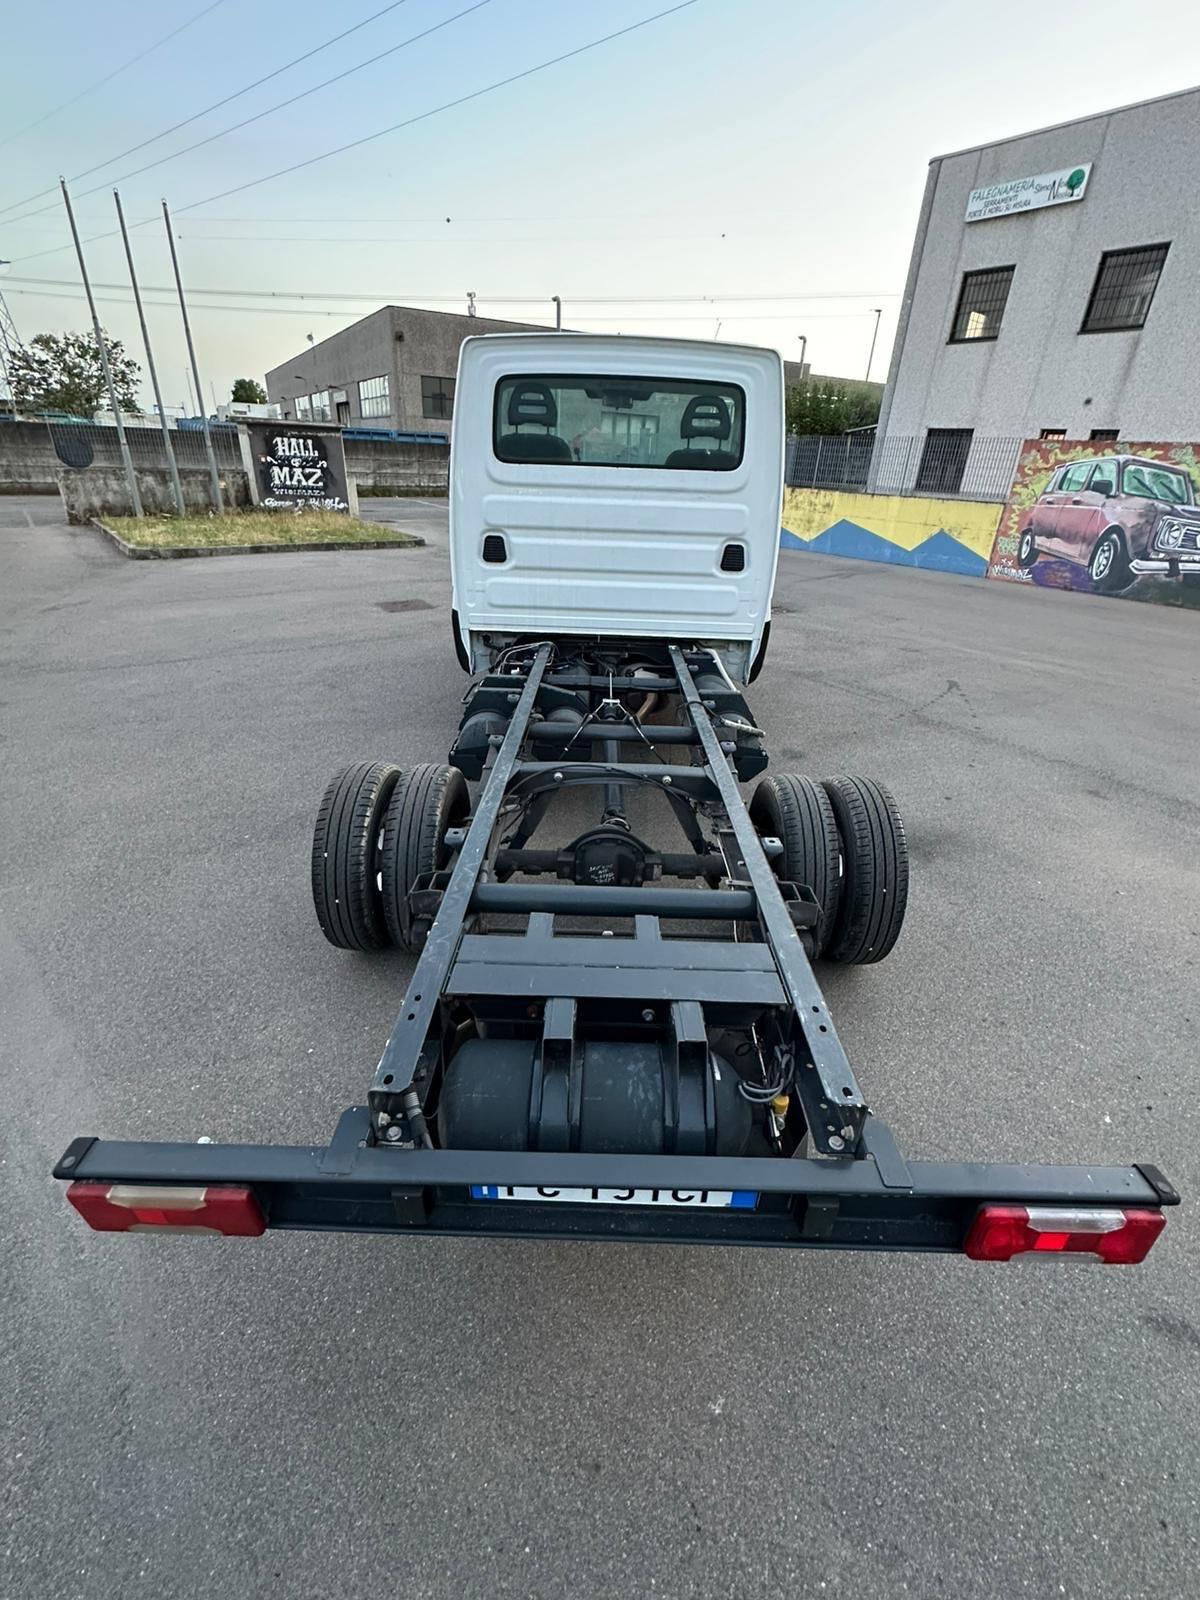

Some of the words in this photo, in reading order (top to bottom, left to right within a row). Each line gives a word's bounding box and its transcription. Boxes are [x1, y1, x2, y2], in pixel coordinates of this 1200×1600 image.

[971, 179, 1035, 202] FALEGNAMERIA
[273, 437, 319, 457] HALL
[271, 466, 324, 487] MAZ
